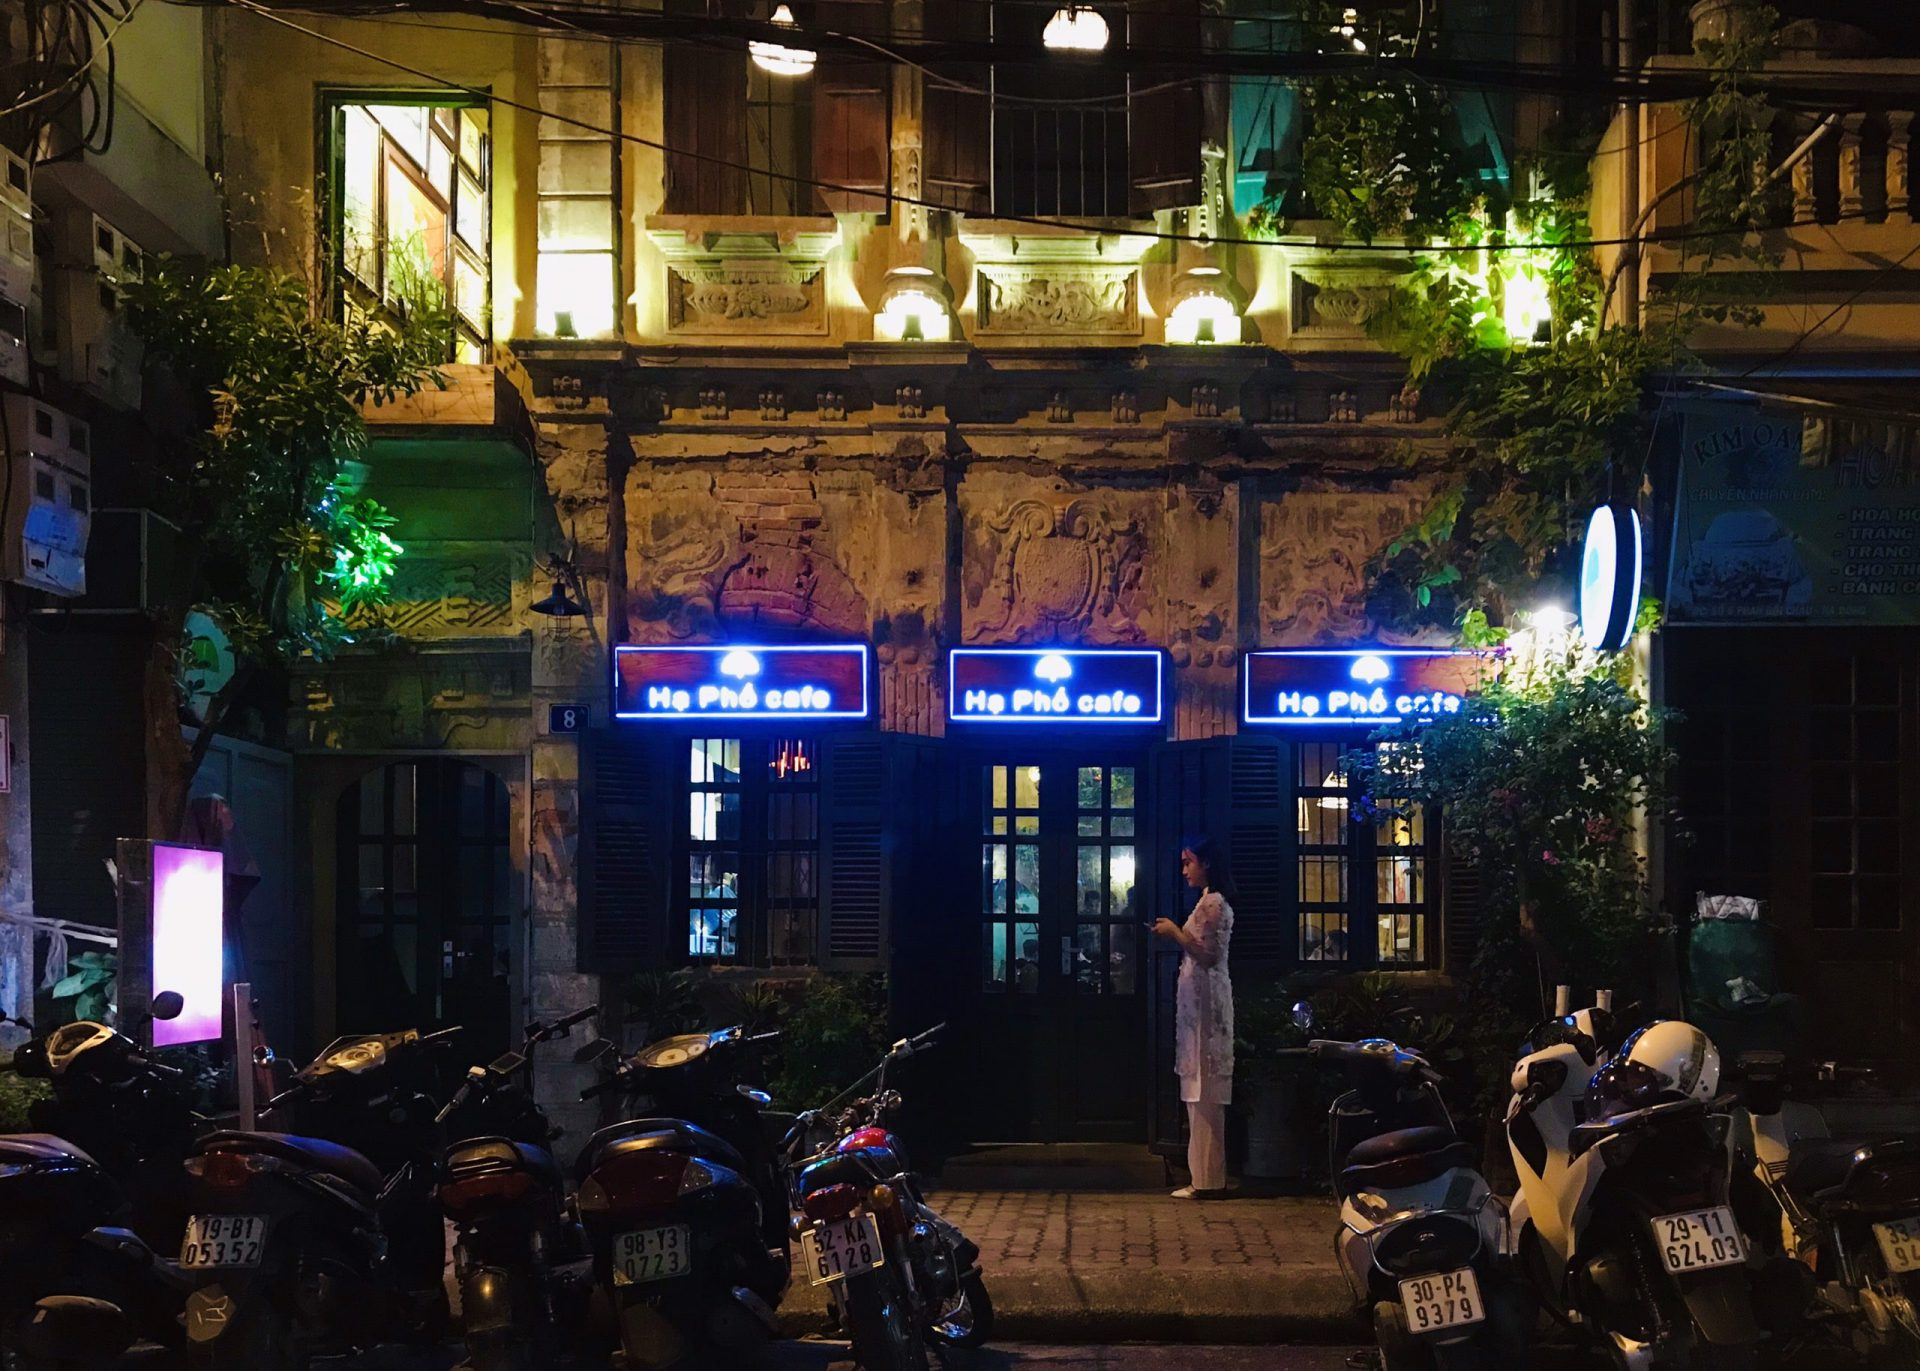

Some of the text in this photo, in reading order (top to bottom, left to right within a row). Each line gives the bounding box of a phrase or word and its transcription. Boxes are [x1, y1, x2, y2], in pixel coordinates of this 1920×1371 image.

[1693, 424, 1744, 465] KIM
[1851, 508, 1891, 522] HOA
[1844, 563, 1885, 577] CHO
[1842, 577, 1897, 595] BÁNH
[765, 685, 831, 709] cafe
[1077, 690, 1141, 713] cafe
[201, 1217, 255, 1240] 19-B1
[623, 1227, 678, 1256] 98-Y3
[812, 1220, 867, 1253] 52-KA
[1665, 1211, 1724, 1243] 29-T1
[1885, 1216, 1920, 1245] 33-
[185, 1241, 258, 1265] 053.52
[625, 1250, 679, 1280] 0723
[817, 1242, 872, 1278] 6128
[1666, 1235, 1740, 1269] 624.03
[1410, 1272, 1467, 1304] 30-P4
[1415, 1297, 1474, 1328] 9379
